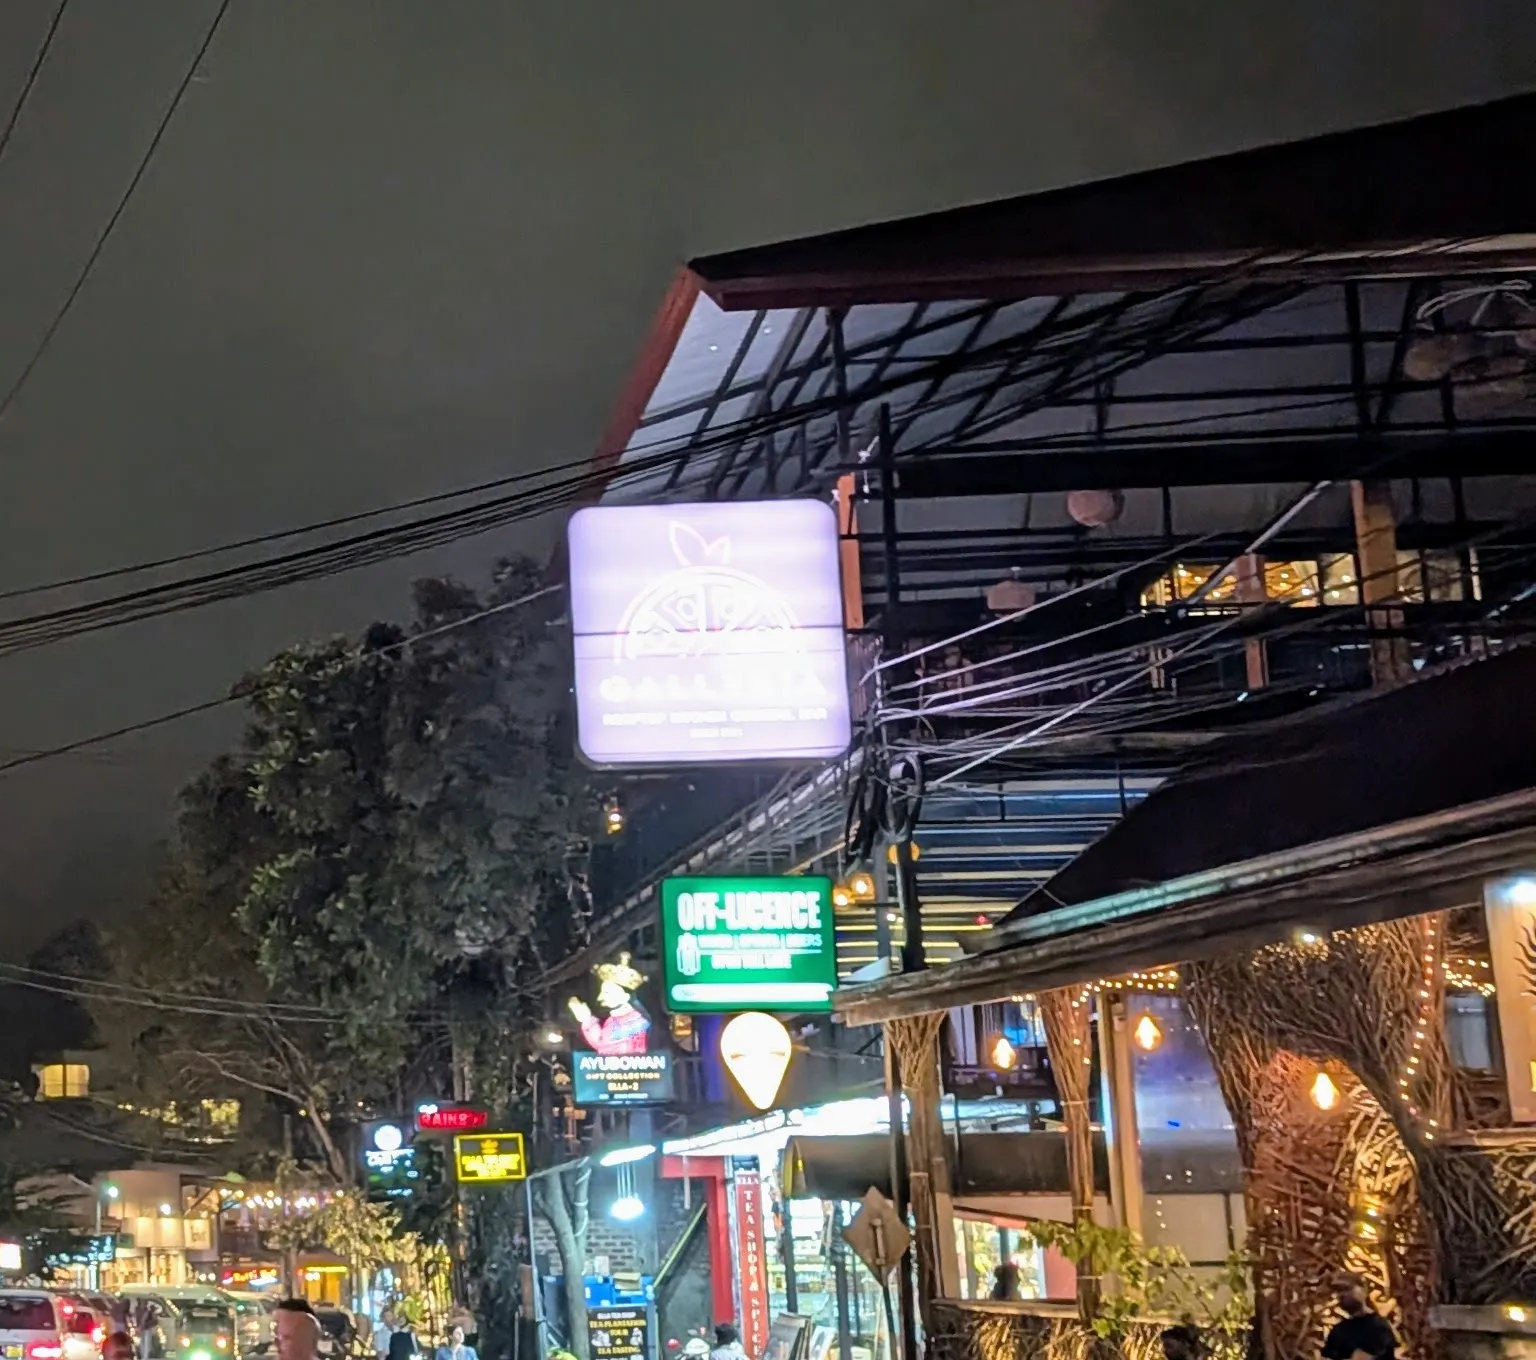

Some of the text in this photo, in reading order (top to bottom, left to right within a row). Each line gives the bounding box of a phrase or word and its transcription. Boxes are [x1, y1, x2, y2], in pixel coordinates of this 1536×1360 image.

[677, 891, 822, 931] OFF-LICENCE
[743, 1190, 755, 1225] TEA
[747, 1230, 759, 1277] SHOP
